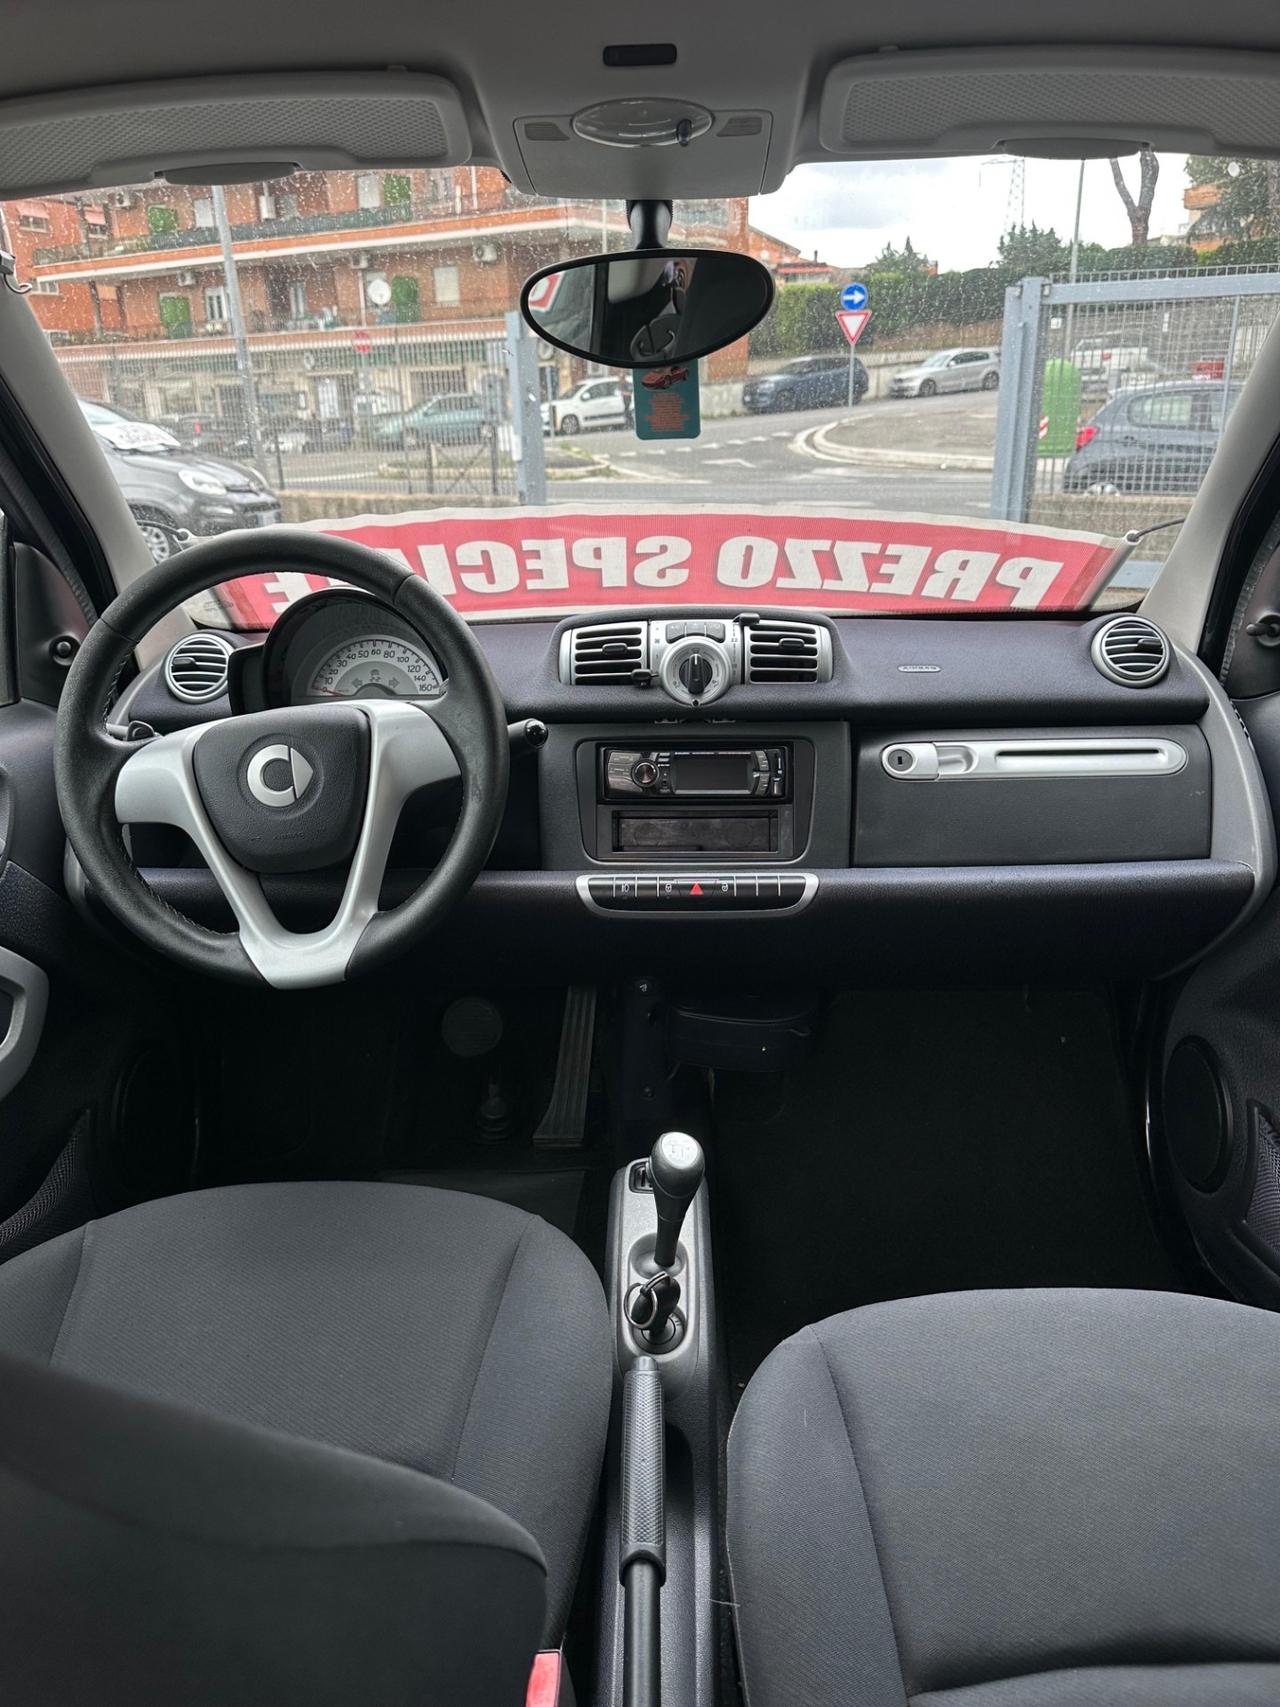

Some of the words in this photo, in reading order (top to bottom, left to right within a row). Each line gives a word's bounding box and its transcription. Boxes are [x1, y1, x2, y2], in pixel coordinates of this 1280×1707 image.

[358, 650, 369, 658] 50
[371, 648, 381, 656] 60
[383, 650, 395, 659] 80
[336, 660, 347, 668] 30
[407, 665, 421, 673] 120
[324, 677, 333, 685] 10
[419, 684, 433, 692] 160
